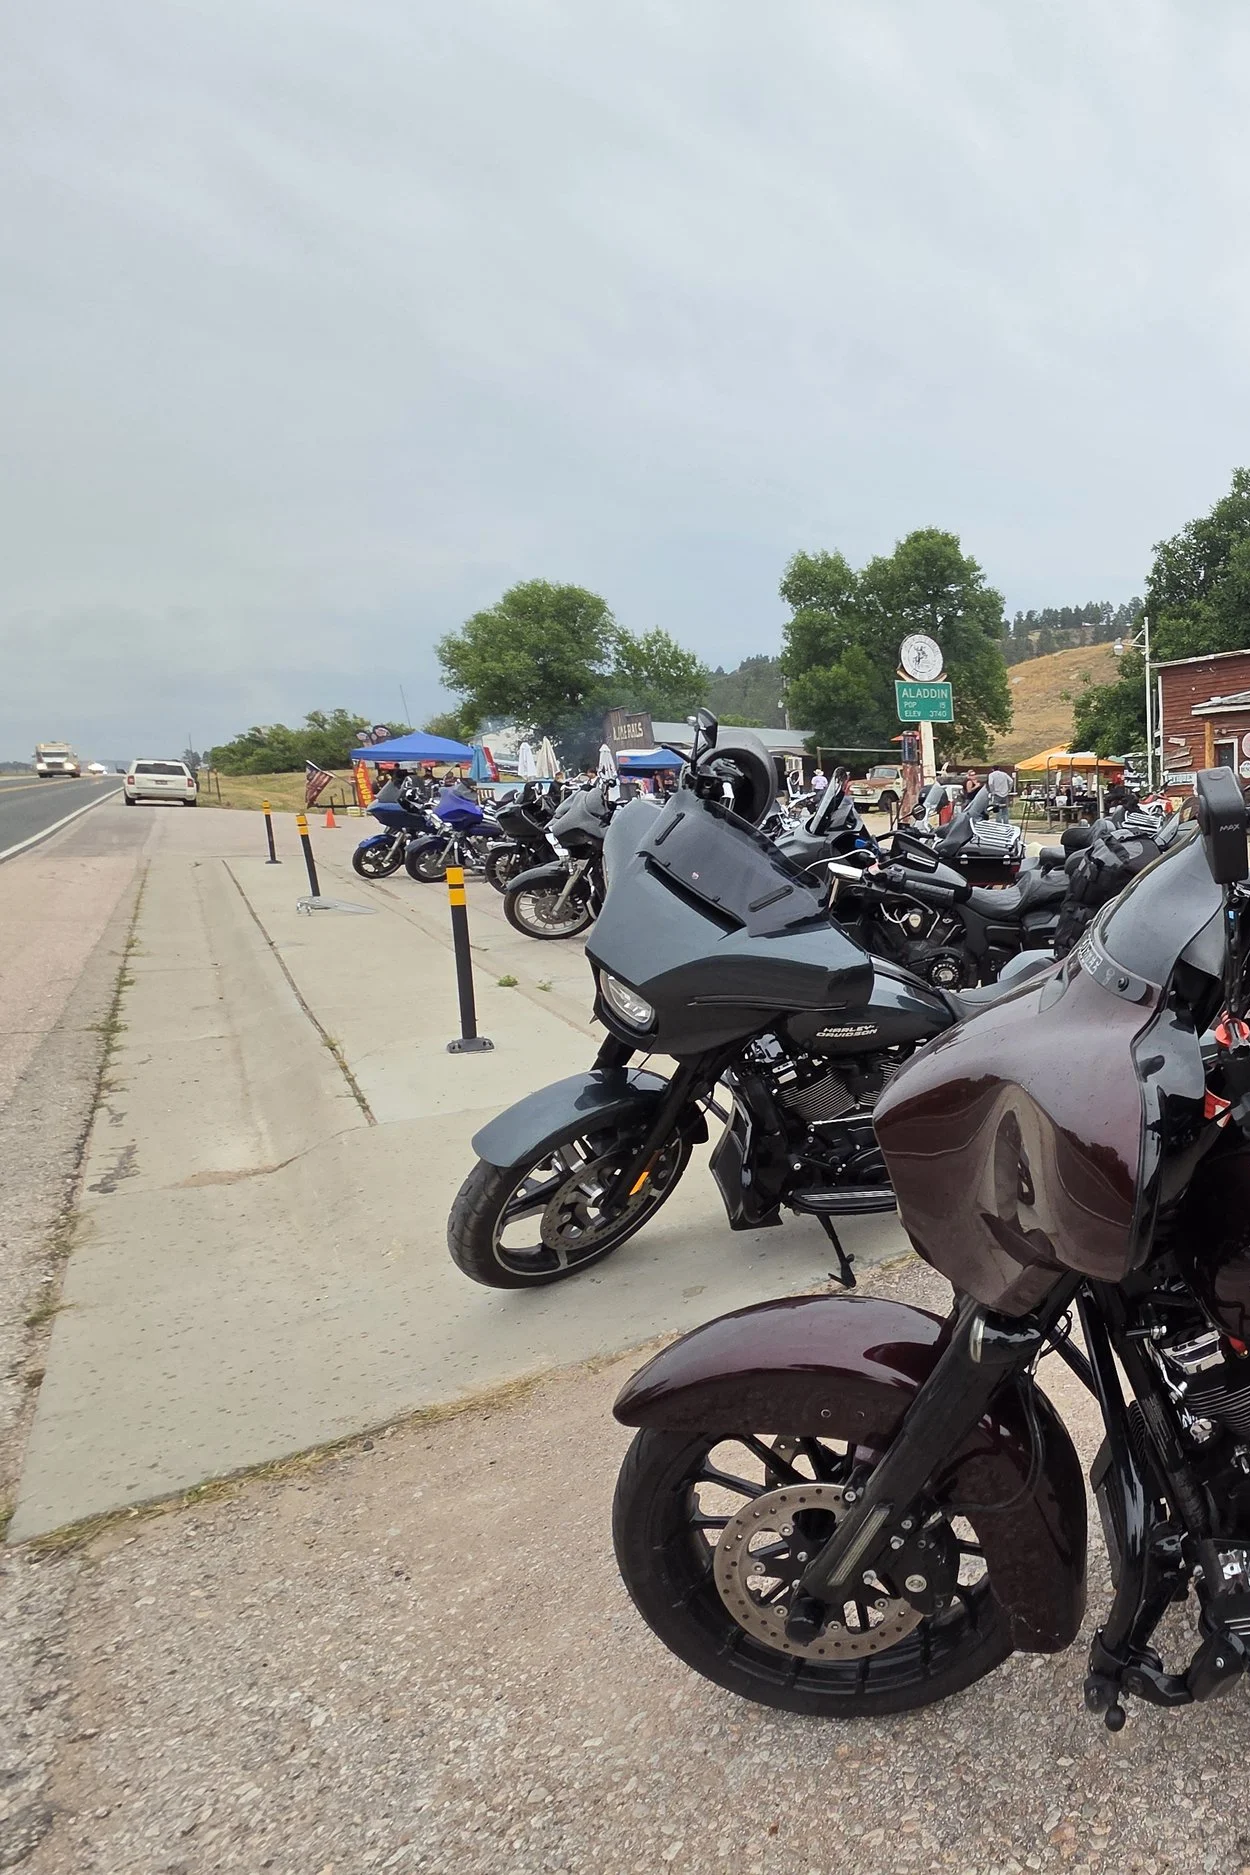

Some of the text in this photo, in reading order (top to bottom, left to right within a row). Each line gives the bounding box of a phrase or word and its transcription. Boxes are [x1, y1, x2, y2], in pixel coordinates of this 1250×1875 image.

[902, 688, 948, 698] ALADDIN
[904, 701, 917, 709] POP
[816, 1029, 878, 1038] DAVIDSON
